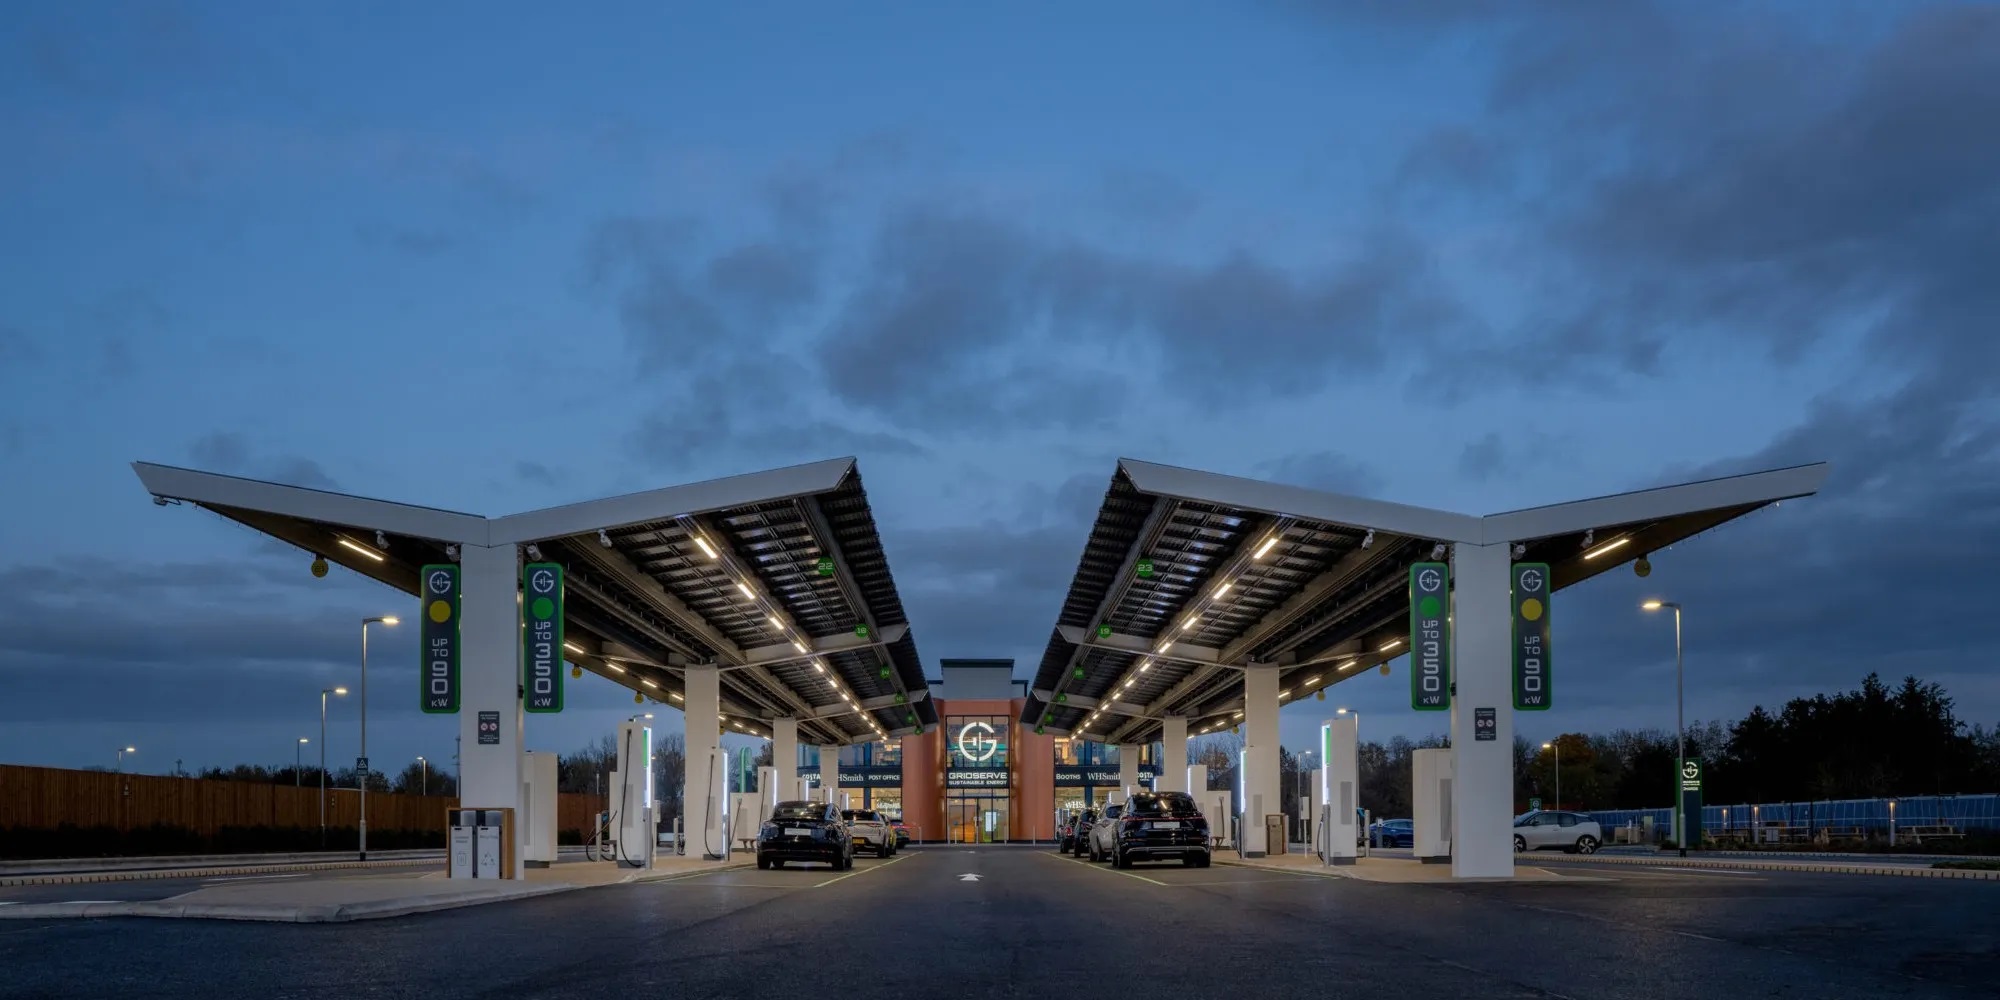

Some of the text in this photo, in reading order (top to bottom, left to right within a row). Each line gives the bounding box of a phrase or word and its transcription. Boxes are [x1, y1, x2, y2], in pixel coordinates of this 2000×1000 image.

[818, 562, 833, 570] 22
[1138, 564, 1152, 572] 23
[535, 621, 551, 630] UP
[1422, 620, 1438, 629] UP
[535, 632, 552, 640] TO
[1422, 630, 1439, 639] TO
[432, 639, 448, 647] UP
[1524, 636, 1540, 644] UP
[432, 649, 448, 657] TO
[1524, 646, 1540, 655] TO
[535, 643, 552, 693] 350
[1423, 641, 1440, 692] 350
[431, 661, 448, 694] 90
[1524, 658, 1541, 692] 90
[838, 773, 864, 781] HSmith
[1087, 772, 1120, 781] WHSmit
